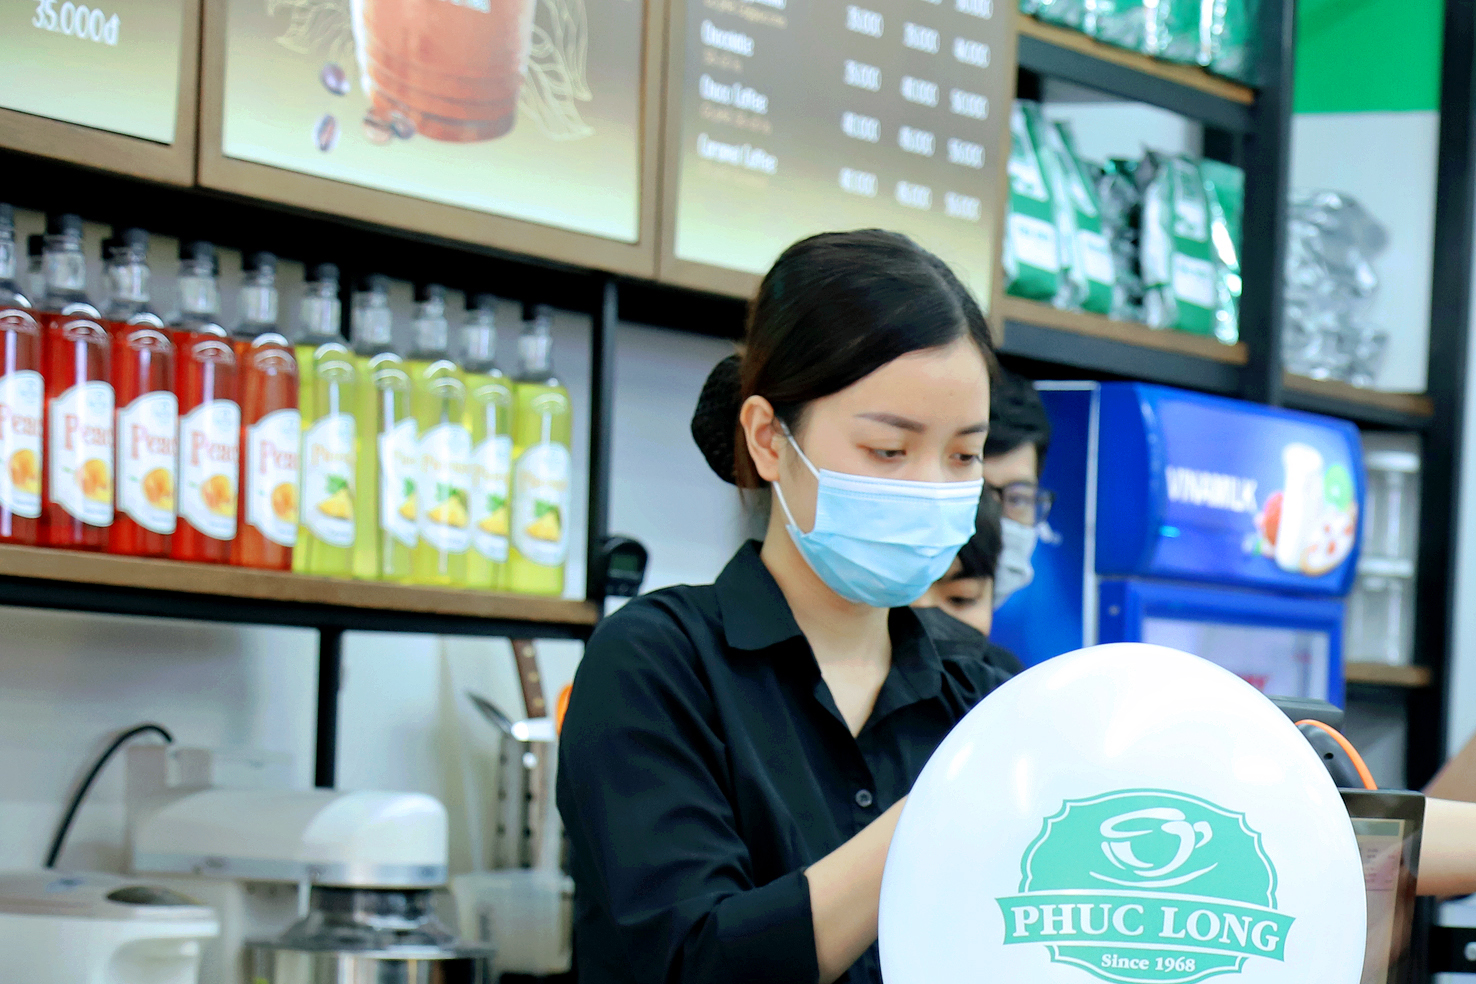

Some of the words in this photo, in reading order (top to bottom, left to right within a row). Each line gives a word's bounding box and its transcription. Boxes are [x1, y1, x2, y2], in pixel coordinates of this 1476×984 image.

[1011, 903, 1144, 937] PHUC
[1158, 906, 1280, 952] LONG
[1101, 953, 1150, 971] Since
[1154, 956, 1196, 973] 1968
